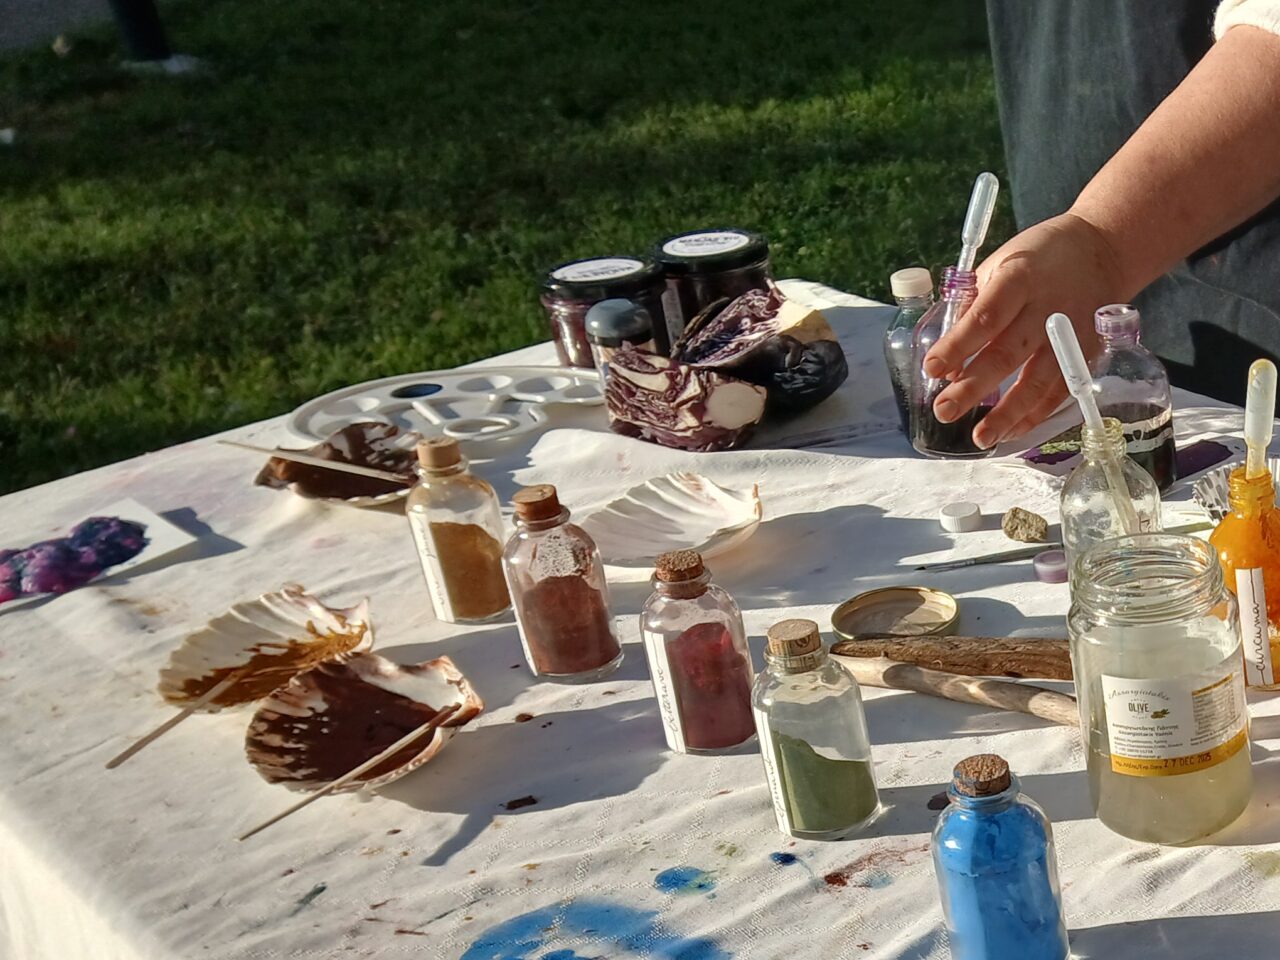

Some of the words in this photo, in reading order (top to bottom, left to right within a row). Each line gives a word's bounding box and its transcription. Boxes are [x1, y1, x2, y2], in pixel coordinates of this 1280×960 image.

[1252, 600, 1266, 673] curcuma
[1127, 702, 1150, 714] OLIVE
[1179, 755, 1195, 767] DEC
